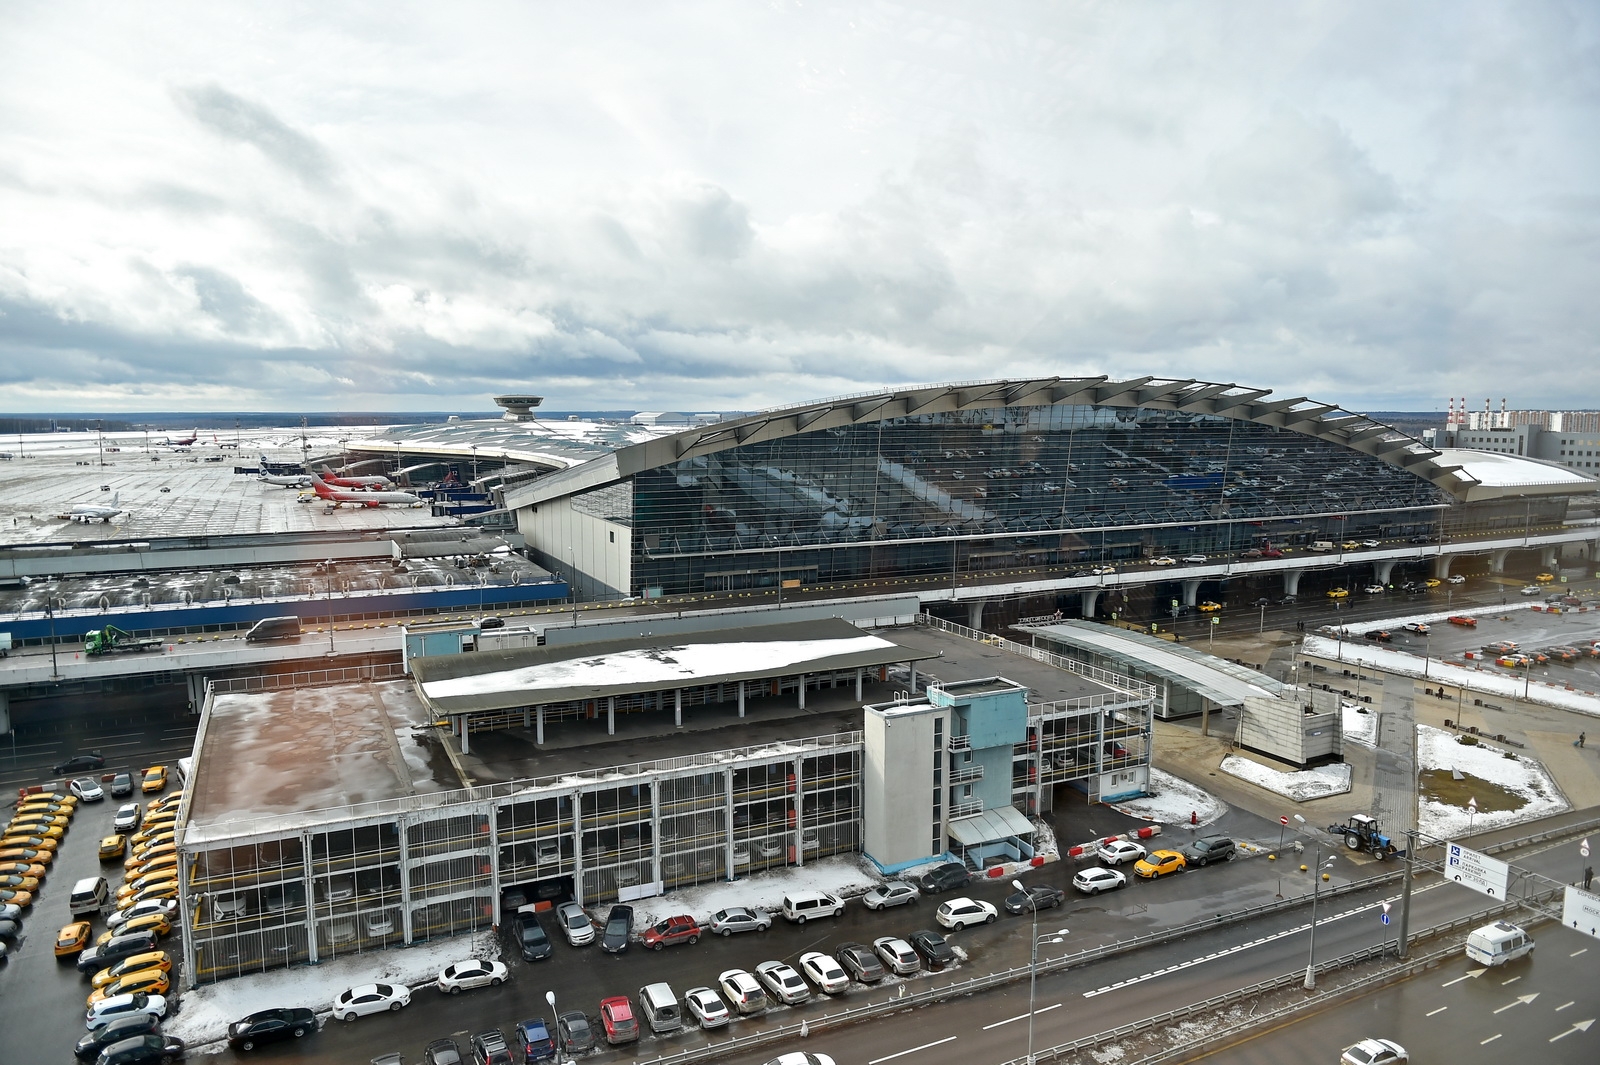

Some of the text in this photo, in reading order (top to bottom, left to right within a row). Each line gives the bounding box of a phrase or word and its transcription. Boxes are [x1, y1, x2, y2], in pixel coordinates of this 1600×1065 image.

[308, 569, 520, 599] ВНУКОВО
[1463, 850, 1481, 859] ПРИЛЕТ
[1463, 855, 1481, 864] ARRIVAL
[1461, 866, 1481, 877] PARKING
[1462, 862, 1487, 875] ПАРКОВКА
